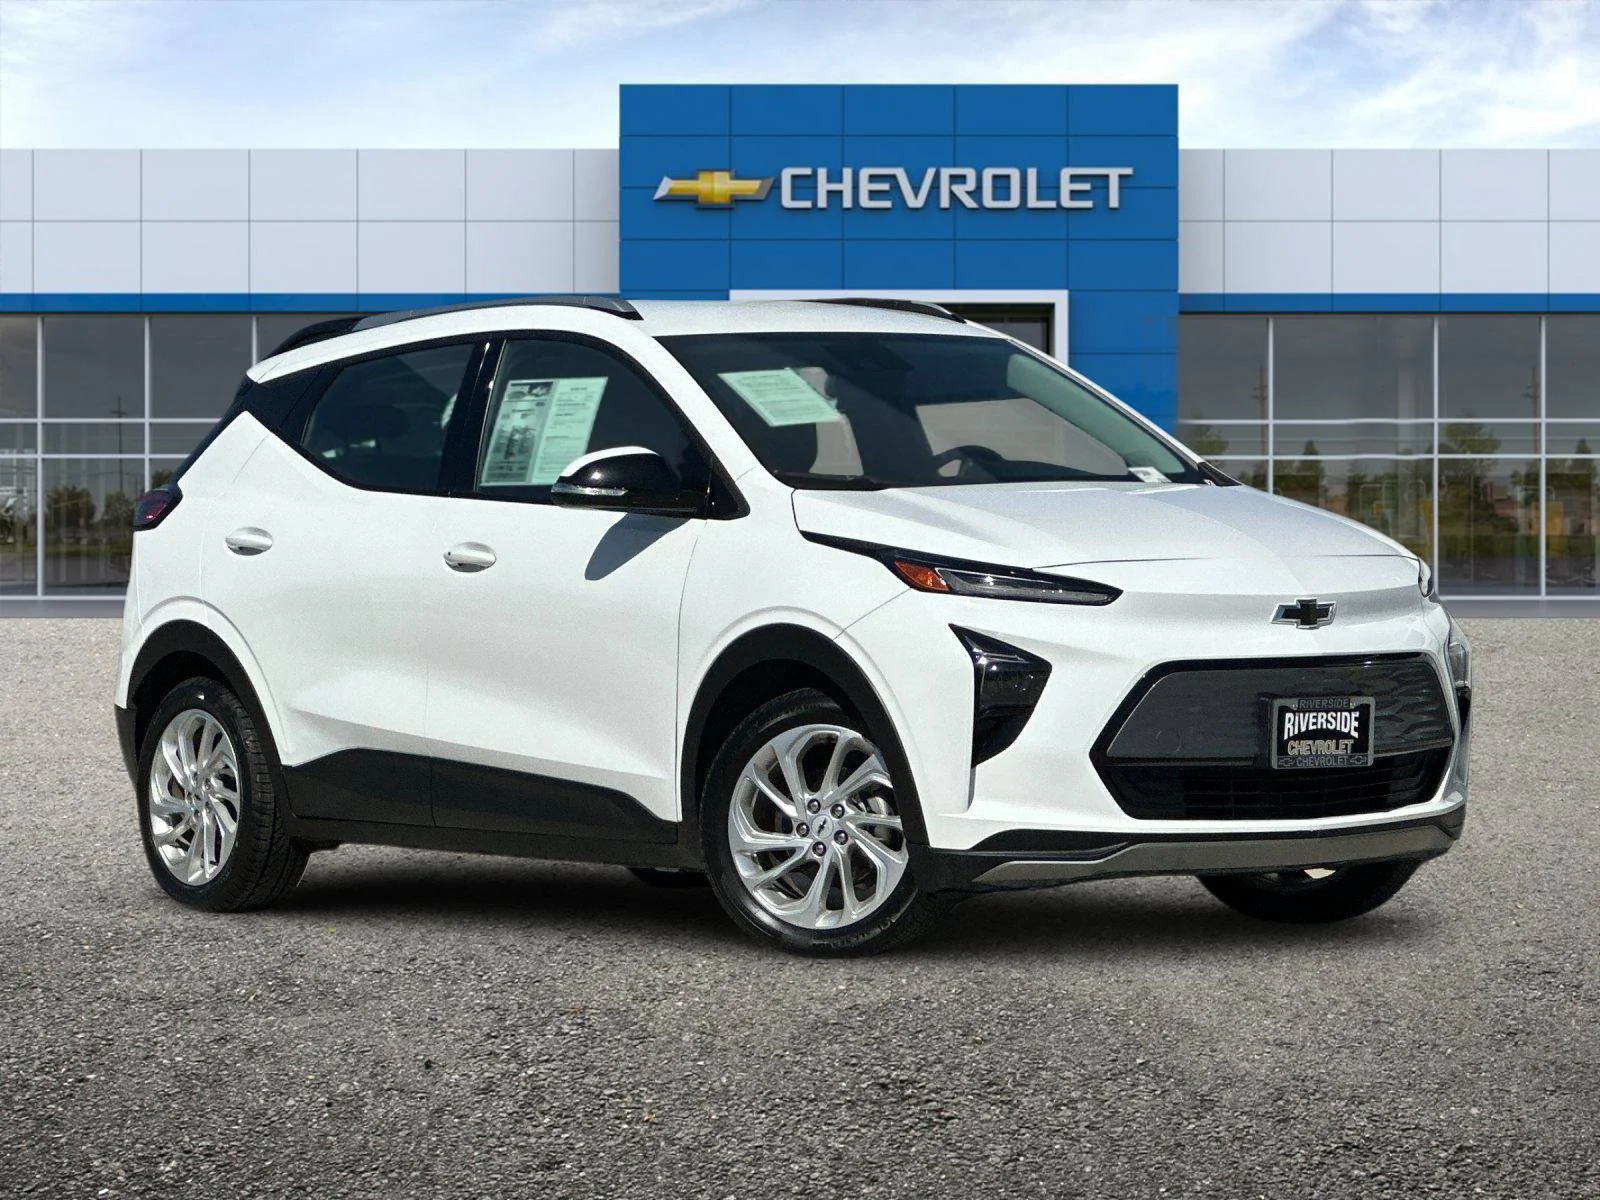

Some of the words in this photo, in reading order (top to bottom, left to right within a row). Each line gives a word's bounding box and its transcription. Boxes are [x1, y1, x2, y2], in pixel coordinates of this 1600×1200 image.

[780, 167, 1134, 209] CHEVROLET
[1300, 698, 1350, 710] RIVERSIDE
[1284, 711, 1360, 740] RIVERSIDE
[1287, 739, 1354, 755] CHEVROLET
[1296, 755, 1349, 767] CHEVROLET
